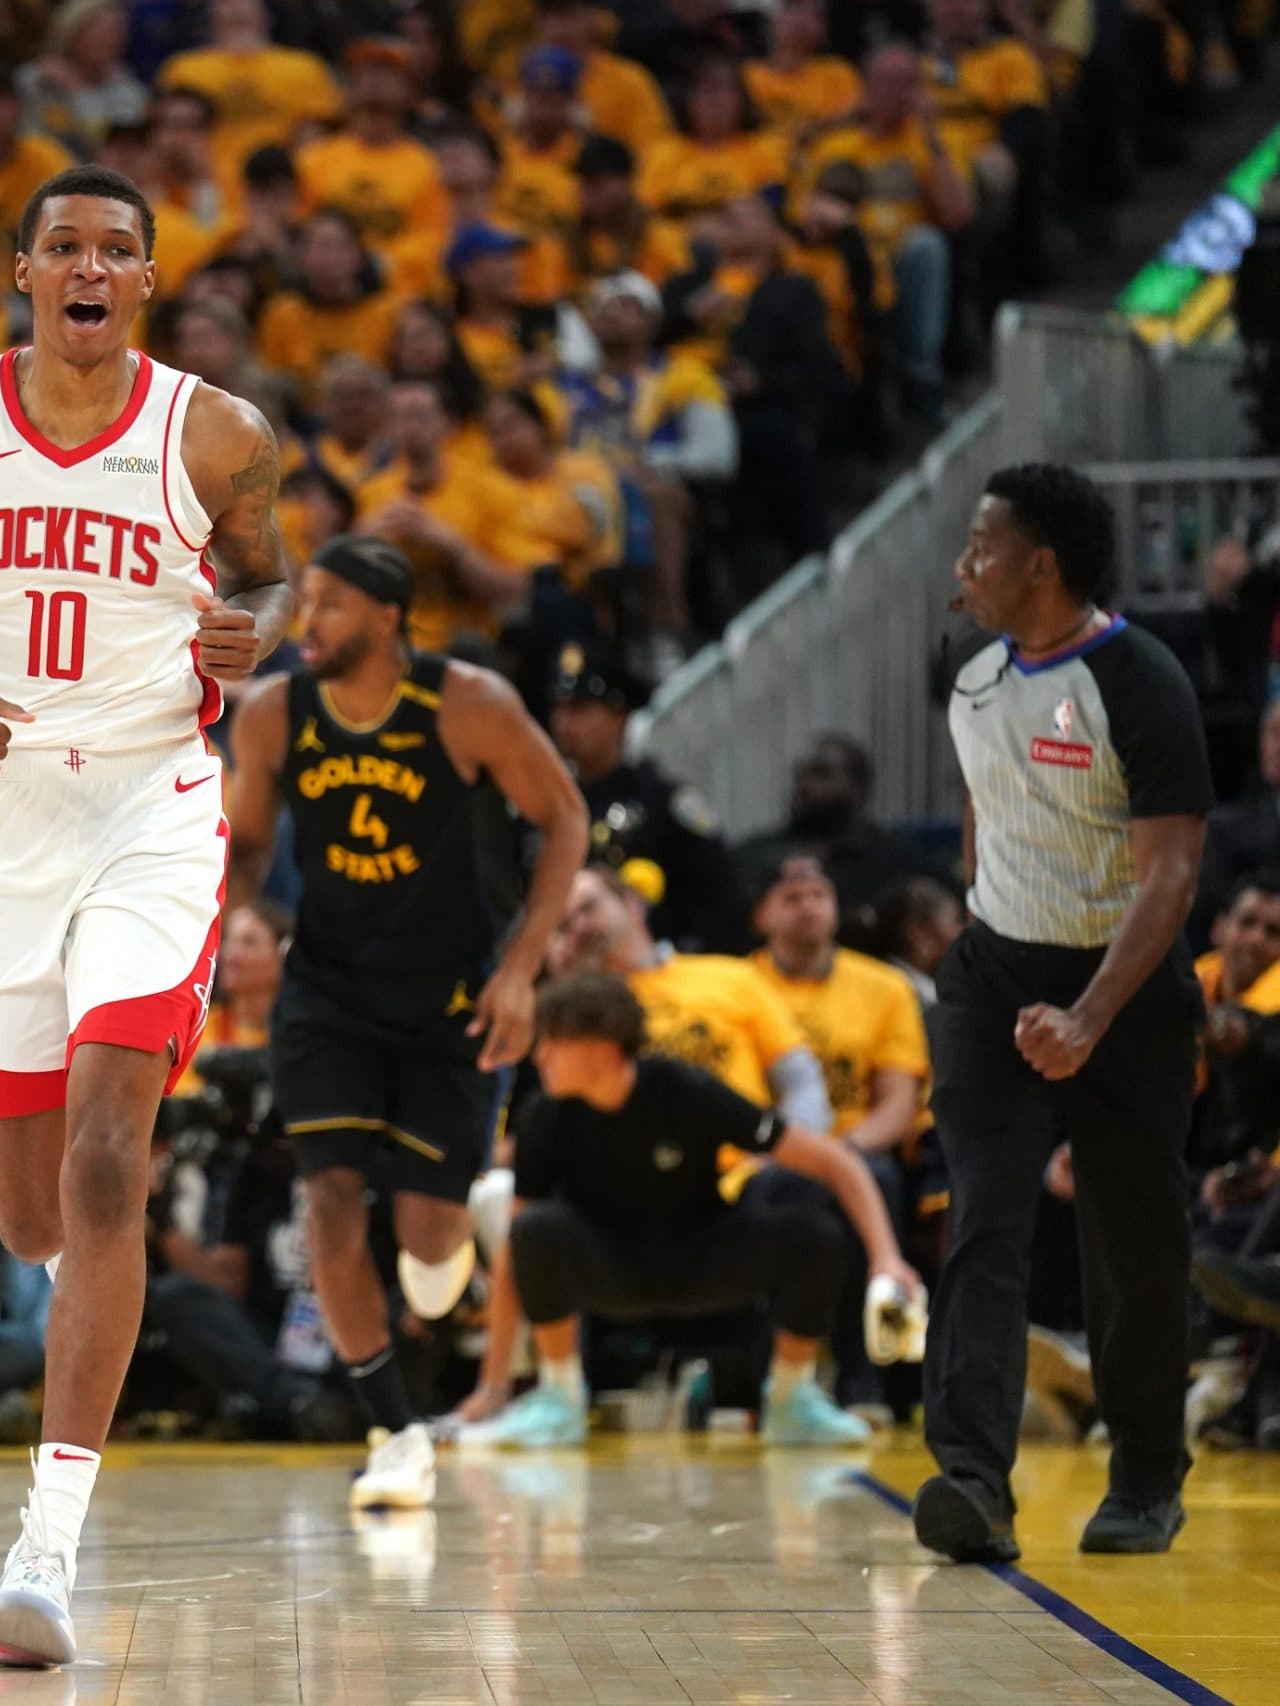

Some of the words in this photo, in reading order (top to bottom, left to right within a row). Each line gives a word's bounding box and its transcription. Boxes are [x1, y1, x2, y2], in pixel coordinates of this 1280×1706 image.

[102, 463, 159, 474] HERMANN
[103, 456, 158, 468] MEMORIAL
[24, 590, 87, 682] 10
[298, 755, 426, 803] GOLDEN
[350, 794, 389, 848] 4
[326, 844, 421, 884] STATE
